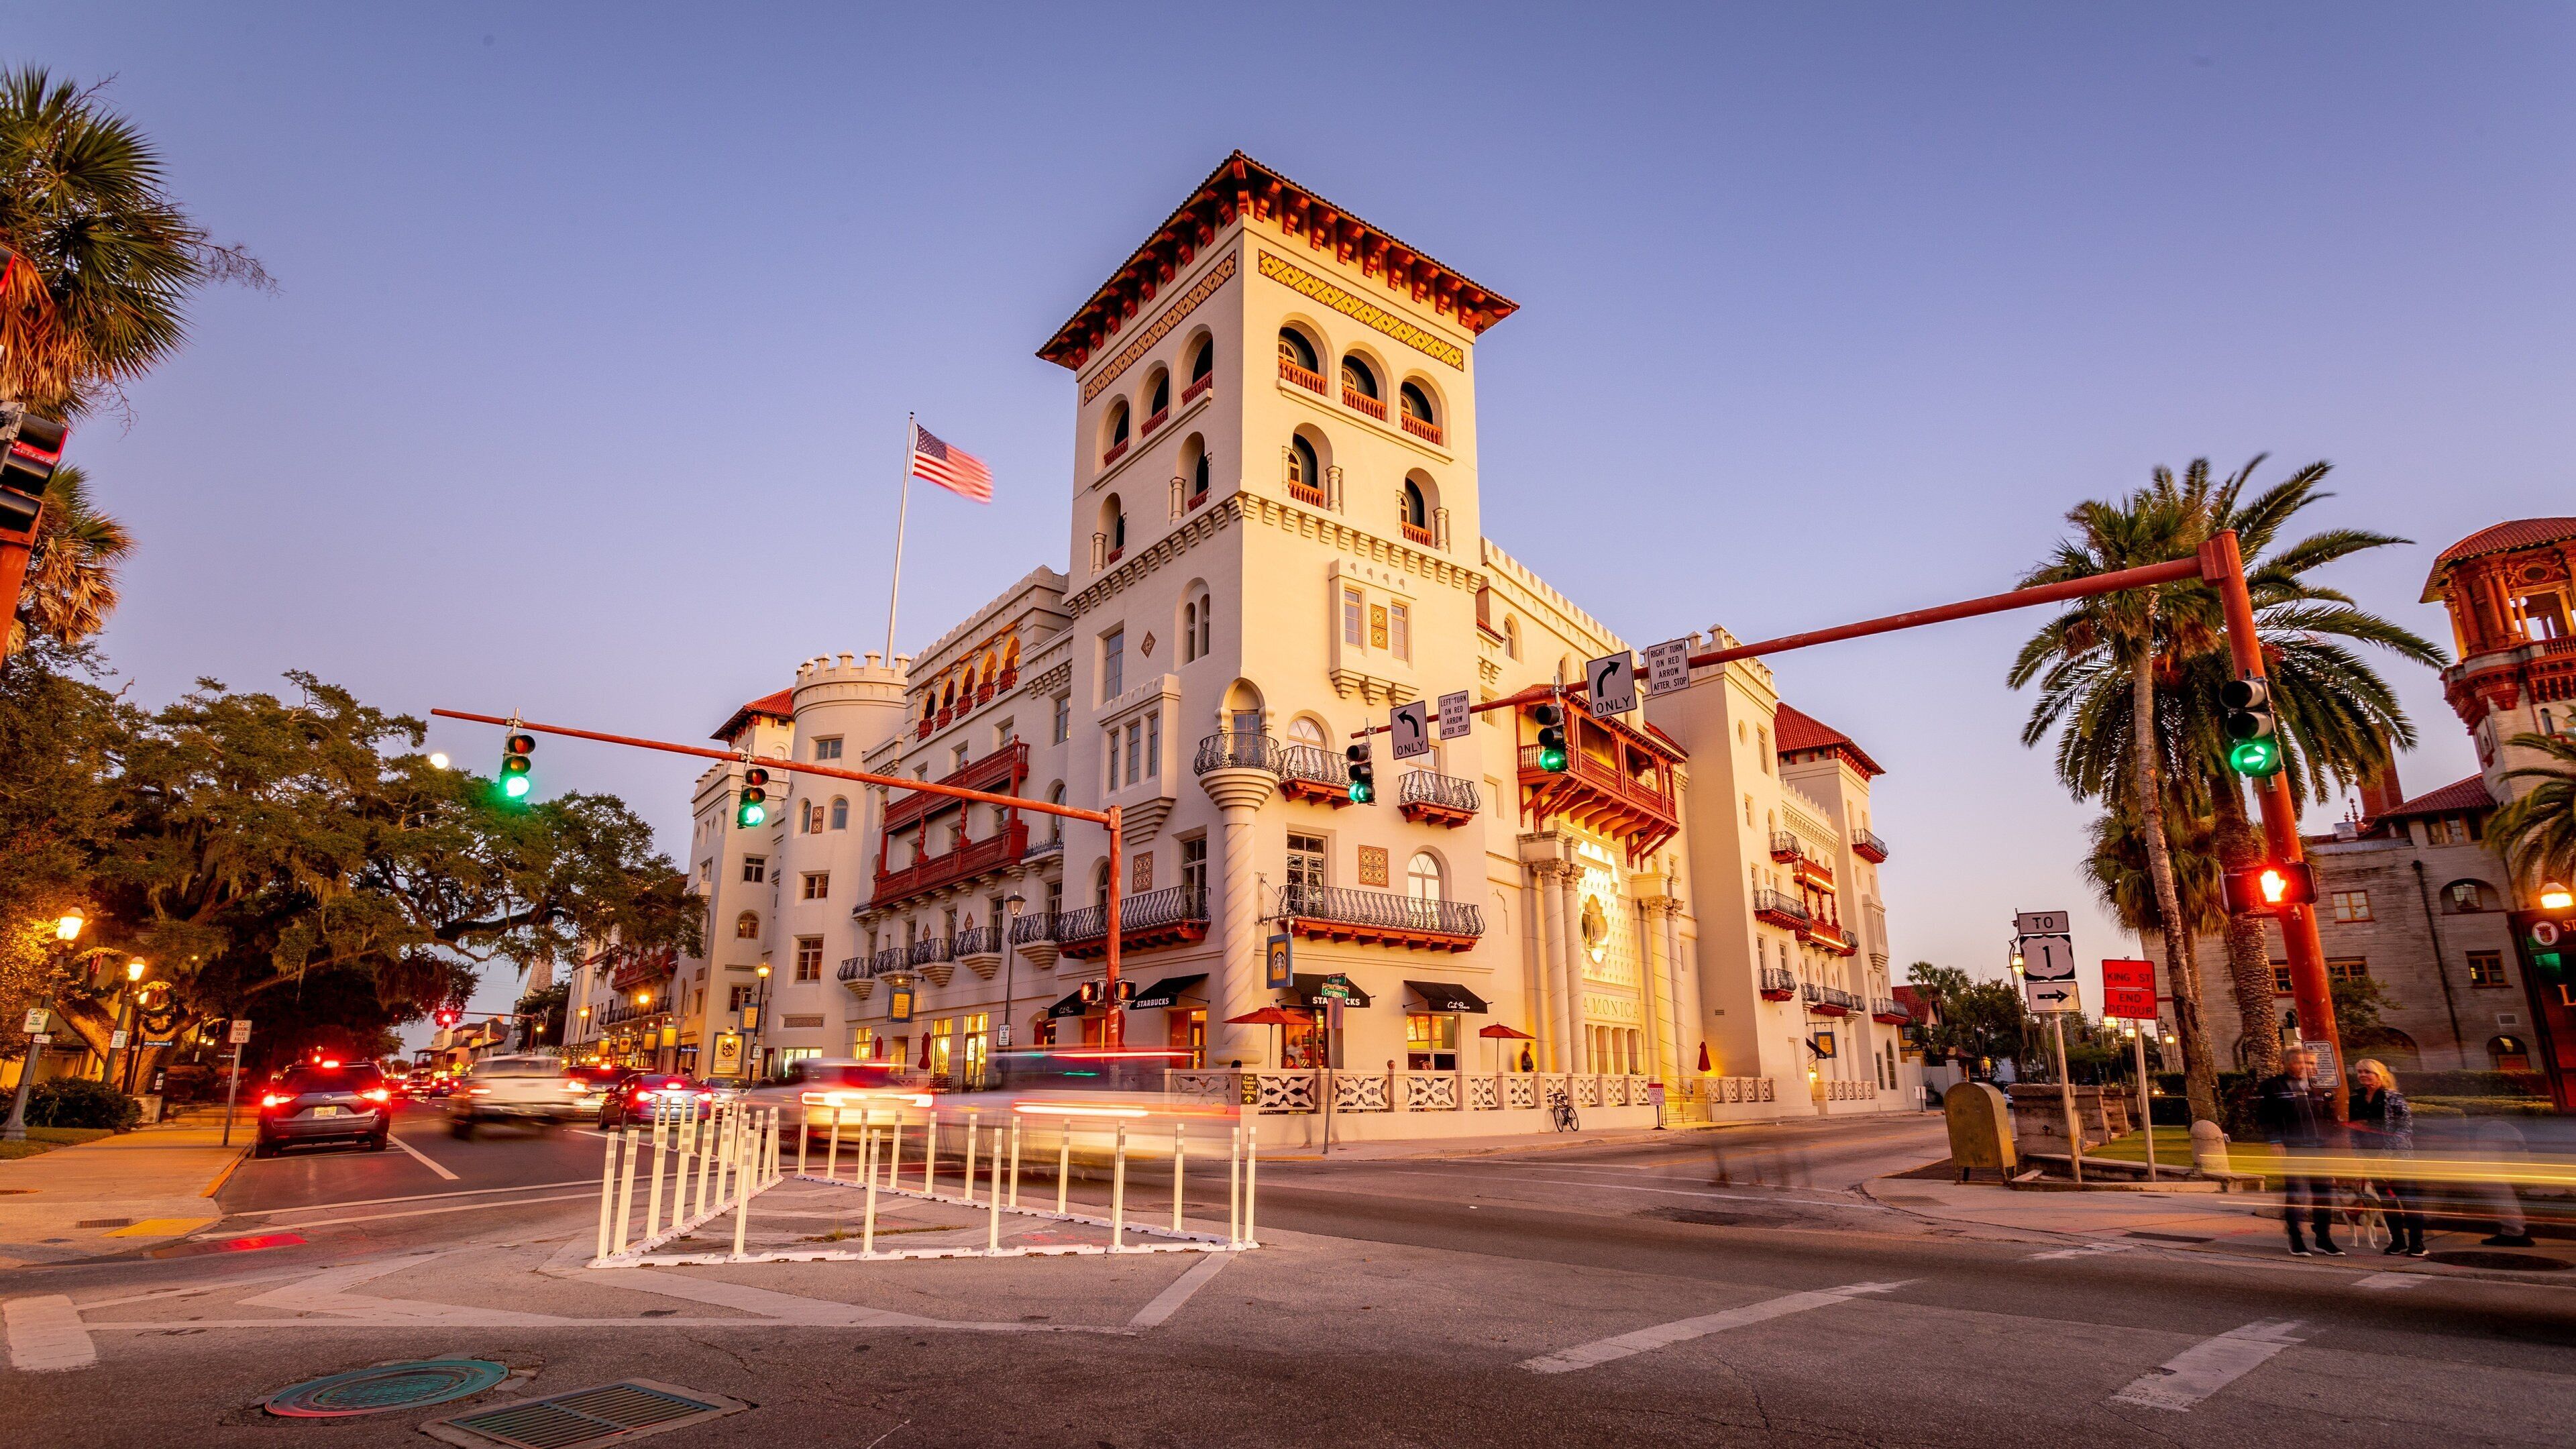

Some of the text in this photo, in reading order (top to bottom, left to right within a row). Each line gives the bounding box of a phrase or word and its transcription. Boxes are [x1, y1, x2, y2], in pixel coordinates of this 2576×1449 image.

[1650, 643, 1683, 658] RIGHT TURN
[1656, 655, 1679, 668] ON RED
[1658, 667, 1679, 679] ARROW
[1654, 676, 1687, 692] AFTER STOP
[1440, 694, 1466, 707] LEFT TURN
[1596, 695, 1630, 714] ONLY
[1444, 705, 1463, 716] ON RED
[1446, 716, 1463, 725] ARROW
[1442, 724, 1468, 737] AFTER STOP
[1397, 740, 1424, 755] ONLY
[2032, 916, 2053, 929] TO
[2042, 945, 2052, 968] 1
[2107, 973, 2151, 983] KING ST
[1324, 989, 1342, 998] Cordova
[2119, 994, 2141, 1004] END
[1136, 998, 1169, 1008] STARBUCKS
[1312, 996, 1360, 1006] STACKS
[1593, 998, 1639, 1019] MONICA
[2108, 1005, 2153, 1016] DETOUR
